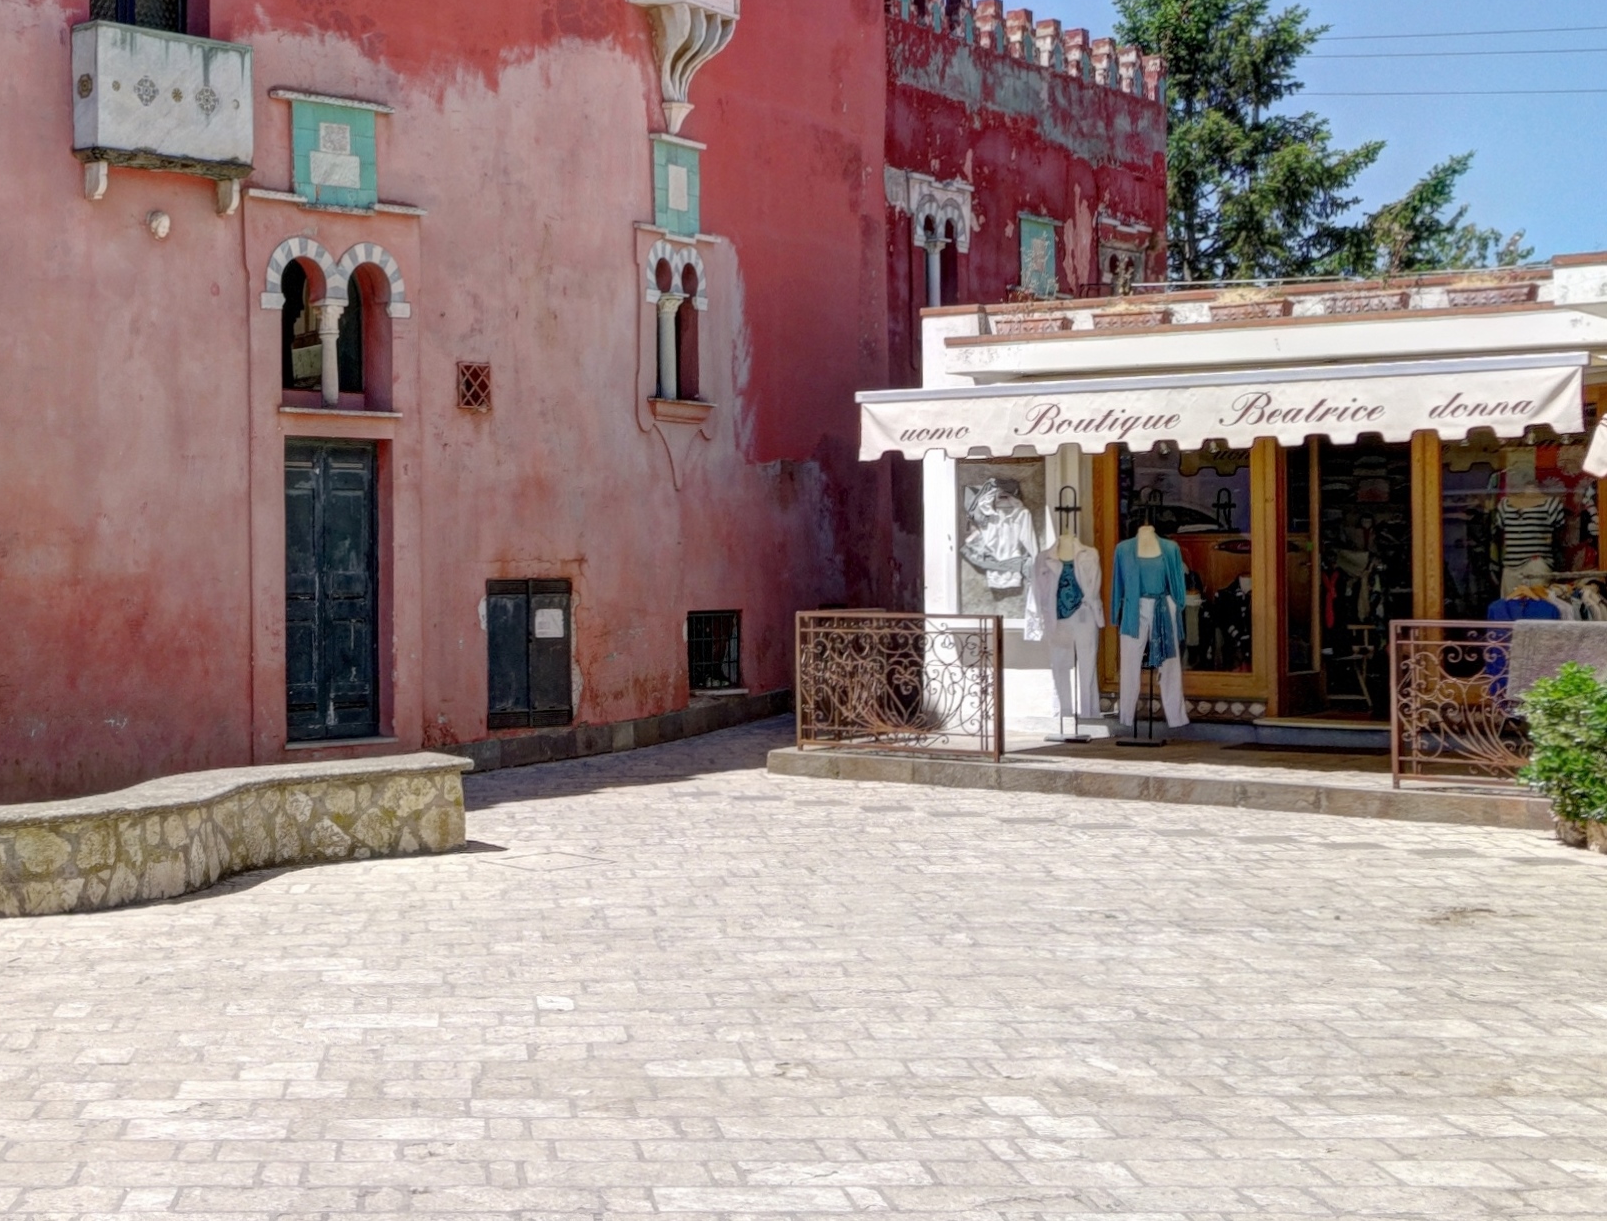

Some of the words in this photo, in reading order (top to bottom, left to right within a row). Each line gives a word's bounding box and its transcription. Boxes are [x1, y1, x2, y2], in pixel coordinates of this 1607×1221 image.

[899, 425, 970, 443] uomo
[1014, 402, 1182, 440] Boutique
[1219, 391, 1386, 427] Beatrice
[1427, 392, 1535, 420] donna
